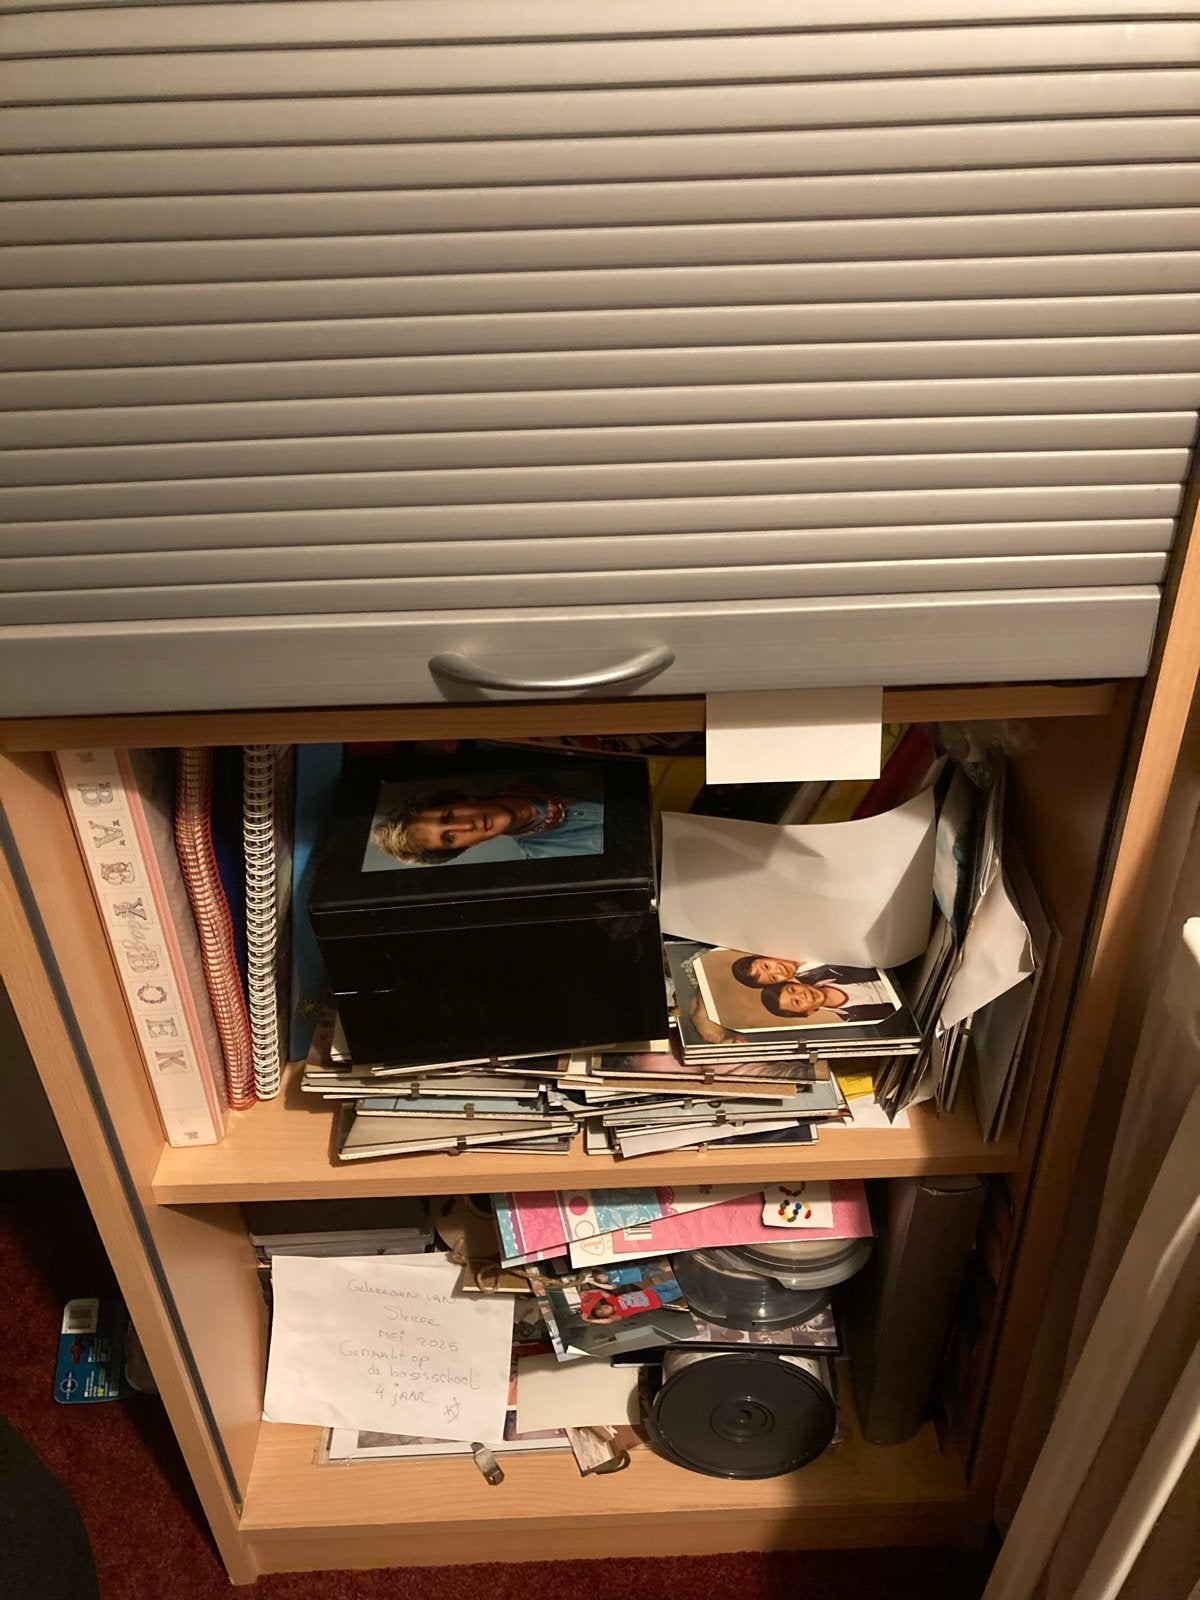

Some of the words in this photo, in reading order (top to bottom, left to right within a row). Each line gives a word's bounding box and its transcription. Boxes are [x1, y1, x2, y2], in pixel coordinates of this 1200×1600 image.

[416, 1337, 459, 1352] 2025
[411, 1355, 430, 1368] op
[367, 1363, 382, 1376] de
[374, 1383, 385, 1399] 4
